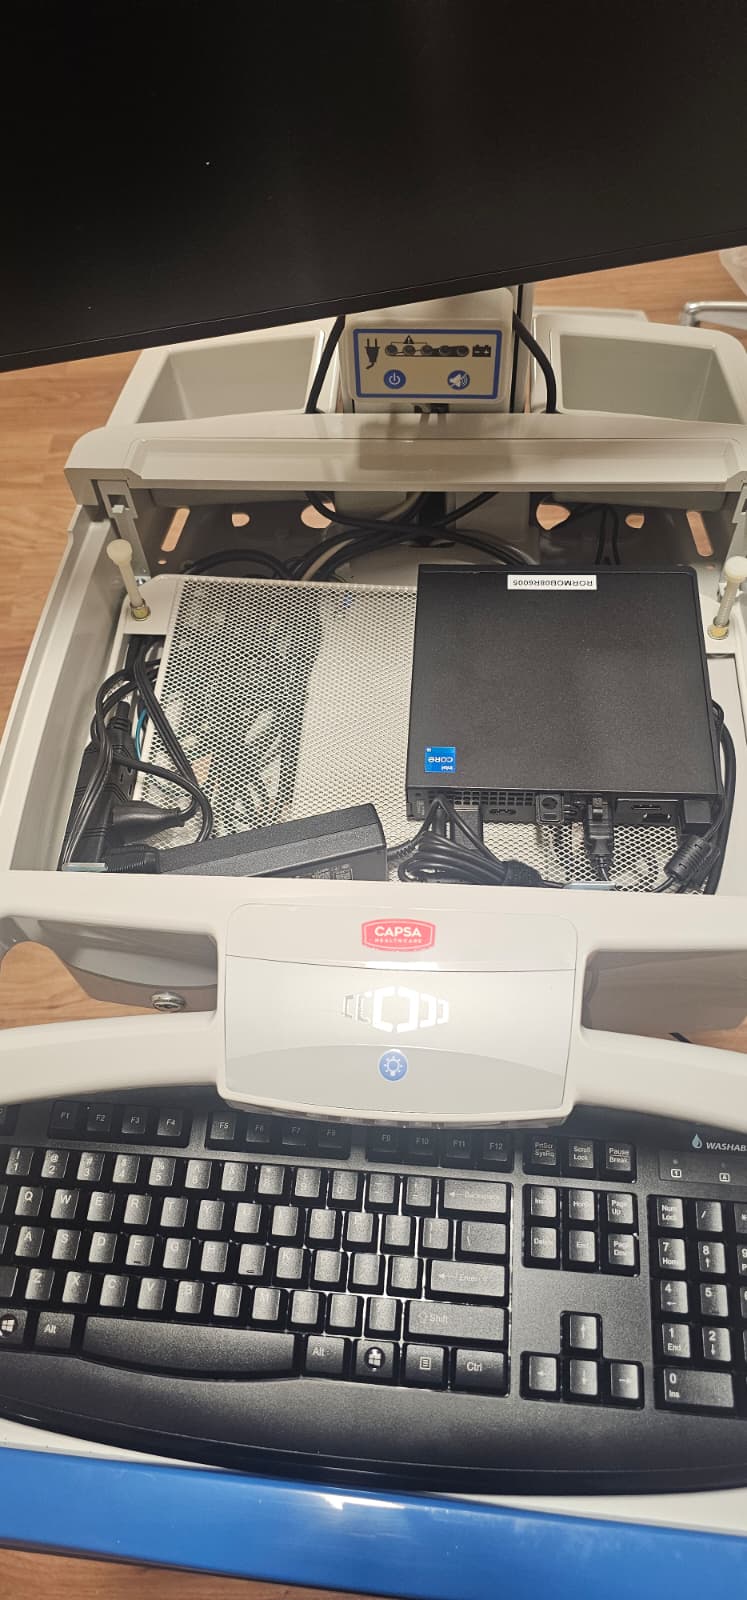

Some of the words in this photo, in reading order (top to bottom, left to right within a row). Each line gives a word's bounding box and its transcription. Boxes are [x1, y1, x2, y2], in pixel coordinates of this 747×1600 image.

[374, 926, 422, 937] CAPSA
[60, 1112, 70, 1120] F1
[96, 1114, 106, 1122] F2
[130, 1116, 140, 1124] F3
[166, 1118, 176, 1126] F4
[219, 1121, 229, 1129] F5
[453, 1140, 465, 1148] F11
[489, 1142, 503, 1151] F12
[573, 1145, 591, 1153] Scroll
[706, 1142, 747, 1152] WASHAB
[609, 1147, 629, 1156] Pause
[48, 1165, 56, 1175] 2
[84, 1168, 91, 1177] 3
[24, 1191, 33, 1202] Q
[60, 1194, 72, 1204] W
[95, 1196, 105, 1206] E
[130, 1198, 140, 1209] R
[167, 1201, 175, 1211] T
[612, 1208, 621, 1216] Up
[23, 1231, 33, 1242] A
[60, 1233, 70, 1244] S
[97, 1236, 106, 1247] D
[133, 1240, 143, 1249] F
[662, 1241, 670, 1252] 7
[703, 1246, 710, 1255] 8
[33, 1272, 43, 1284] Z
[71, 1275, 81, 1287] X
[108, 1278, 118, 1289] C
[146, 1281, 155, 1292] V
[665, 1283, 672, 1293] 4
[185, 1285, 194, 1295] B
[705, 1287, 712, 1297] 5
[43, 1323, 57, 1334] Alt
[668, 1327, 675, 1338] 1
[708, 1330, 717, 1341] 2
[312, 1346, 325, 1357] Alt
[668, 1343, 681, 1351] End
[466, 1361, 482, 1371] Ctrl
[669, 1373, 677, 1384] 0
[669, 1389, 680, 1398] Ins
